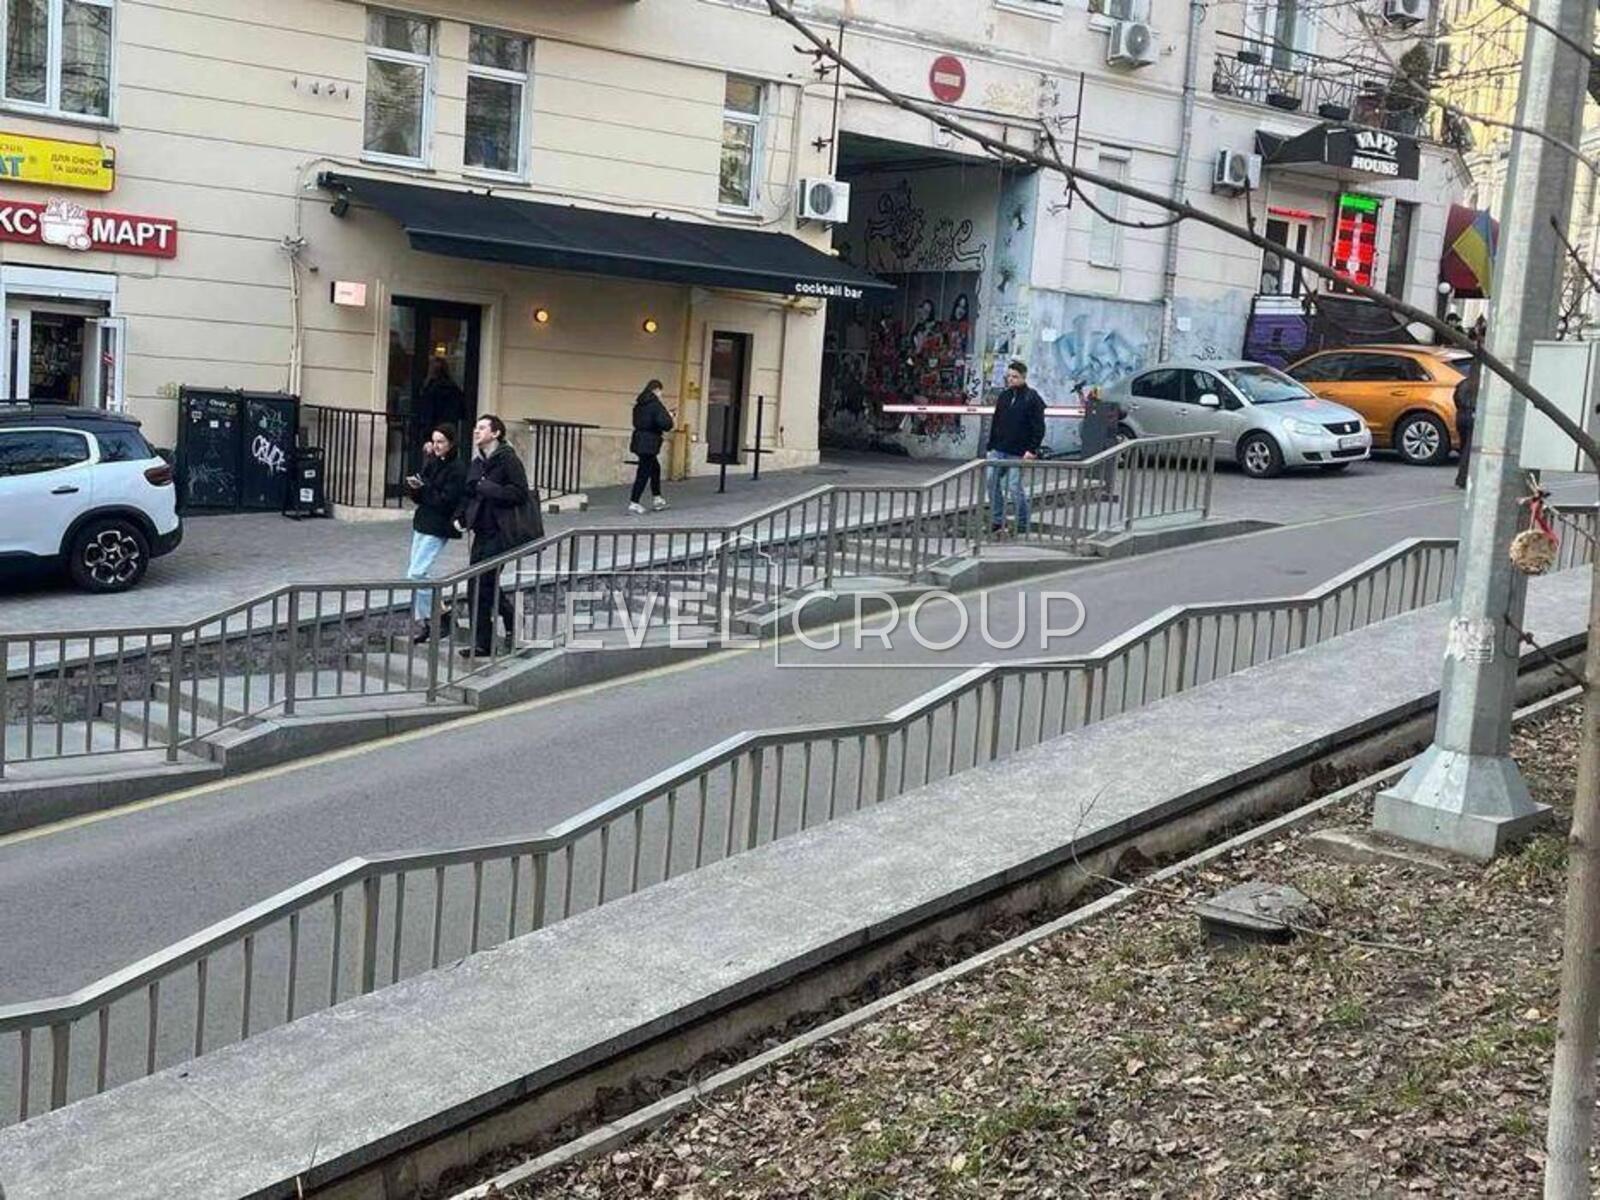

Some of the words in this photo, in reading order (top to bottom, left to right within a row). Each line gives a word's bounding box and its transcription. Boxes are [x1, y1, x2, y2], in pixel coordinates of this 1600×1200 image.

[1355, 131, 1399, 155] VAPE
[53, 163, 63, 173] ТА
[1351, 155, 1399, 176] HOUSE
[91, 217, 172, 248] МАРТ
[795, 282, 842, 296] cocktail
[844, 286, 863, 298] bar
